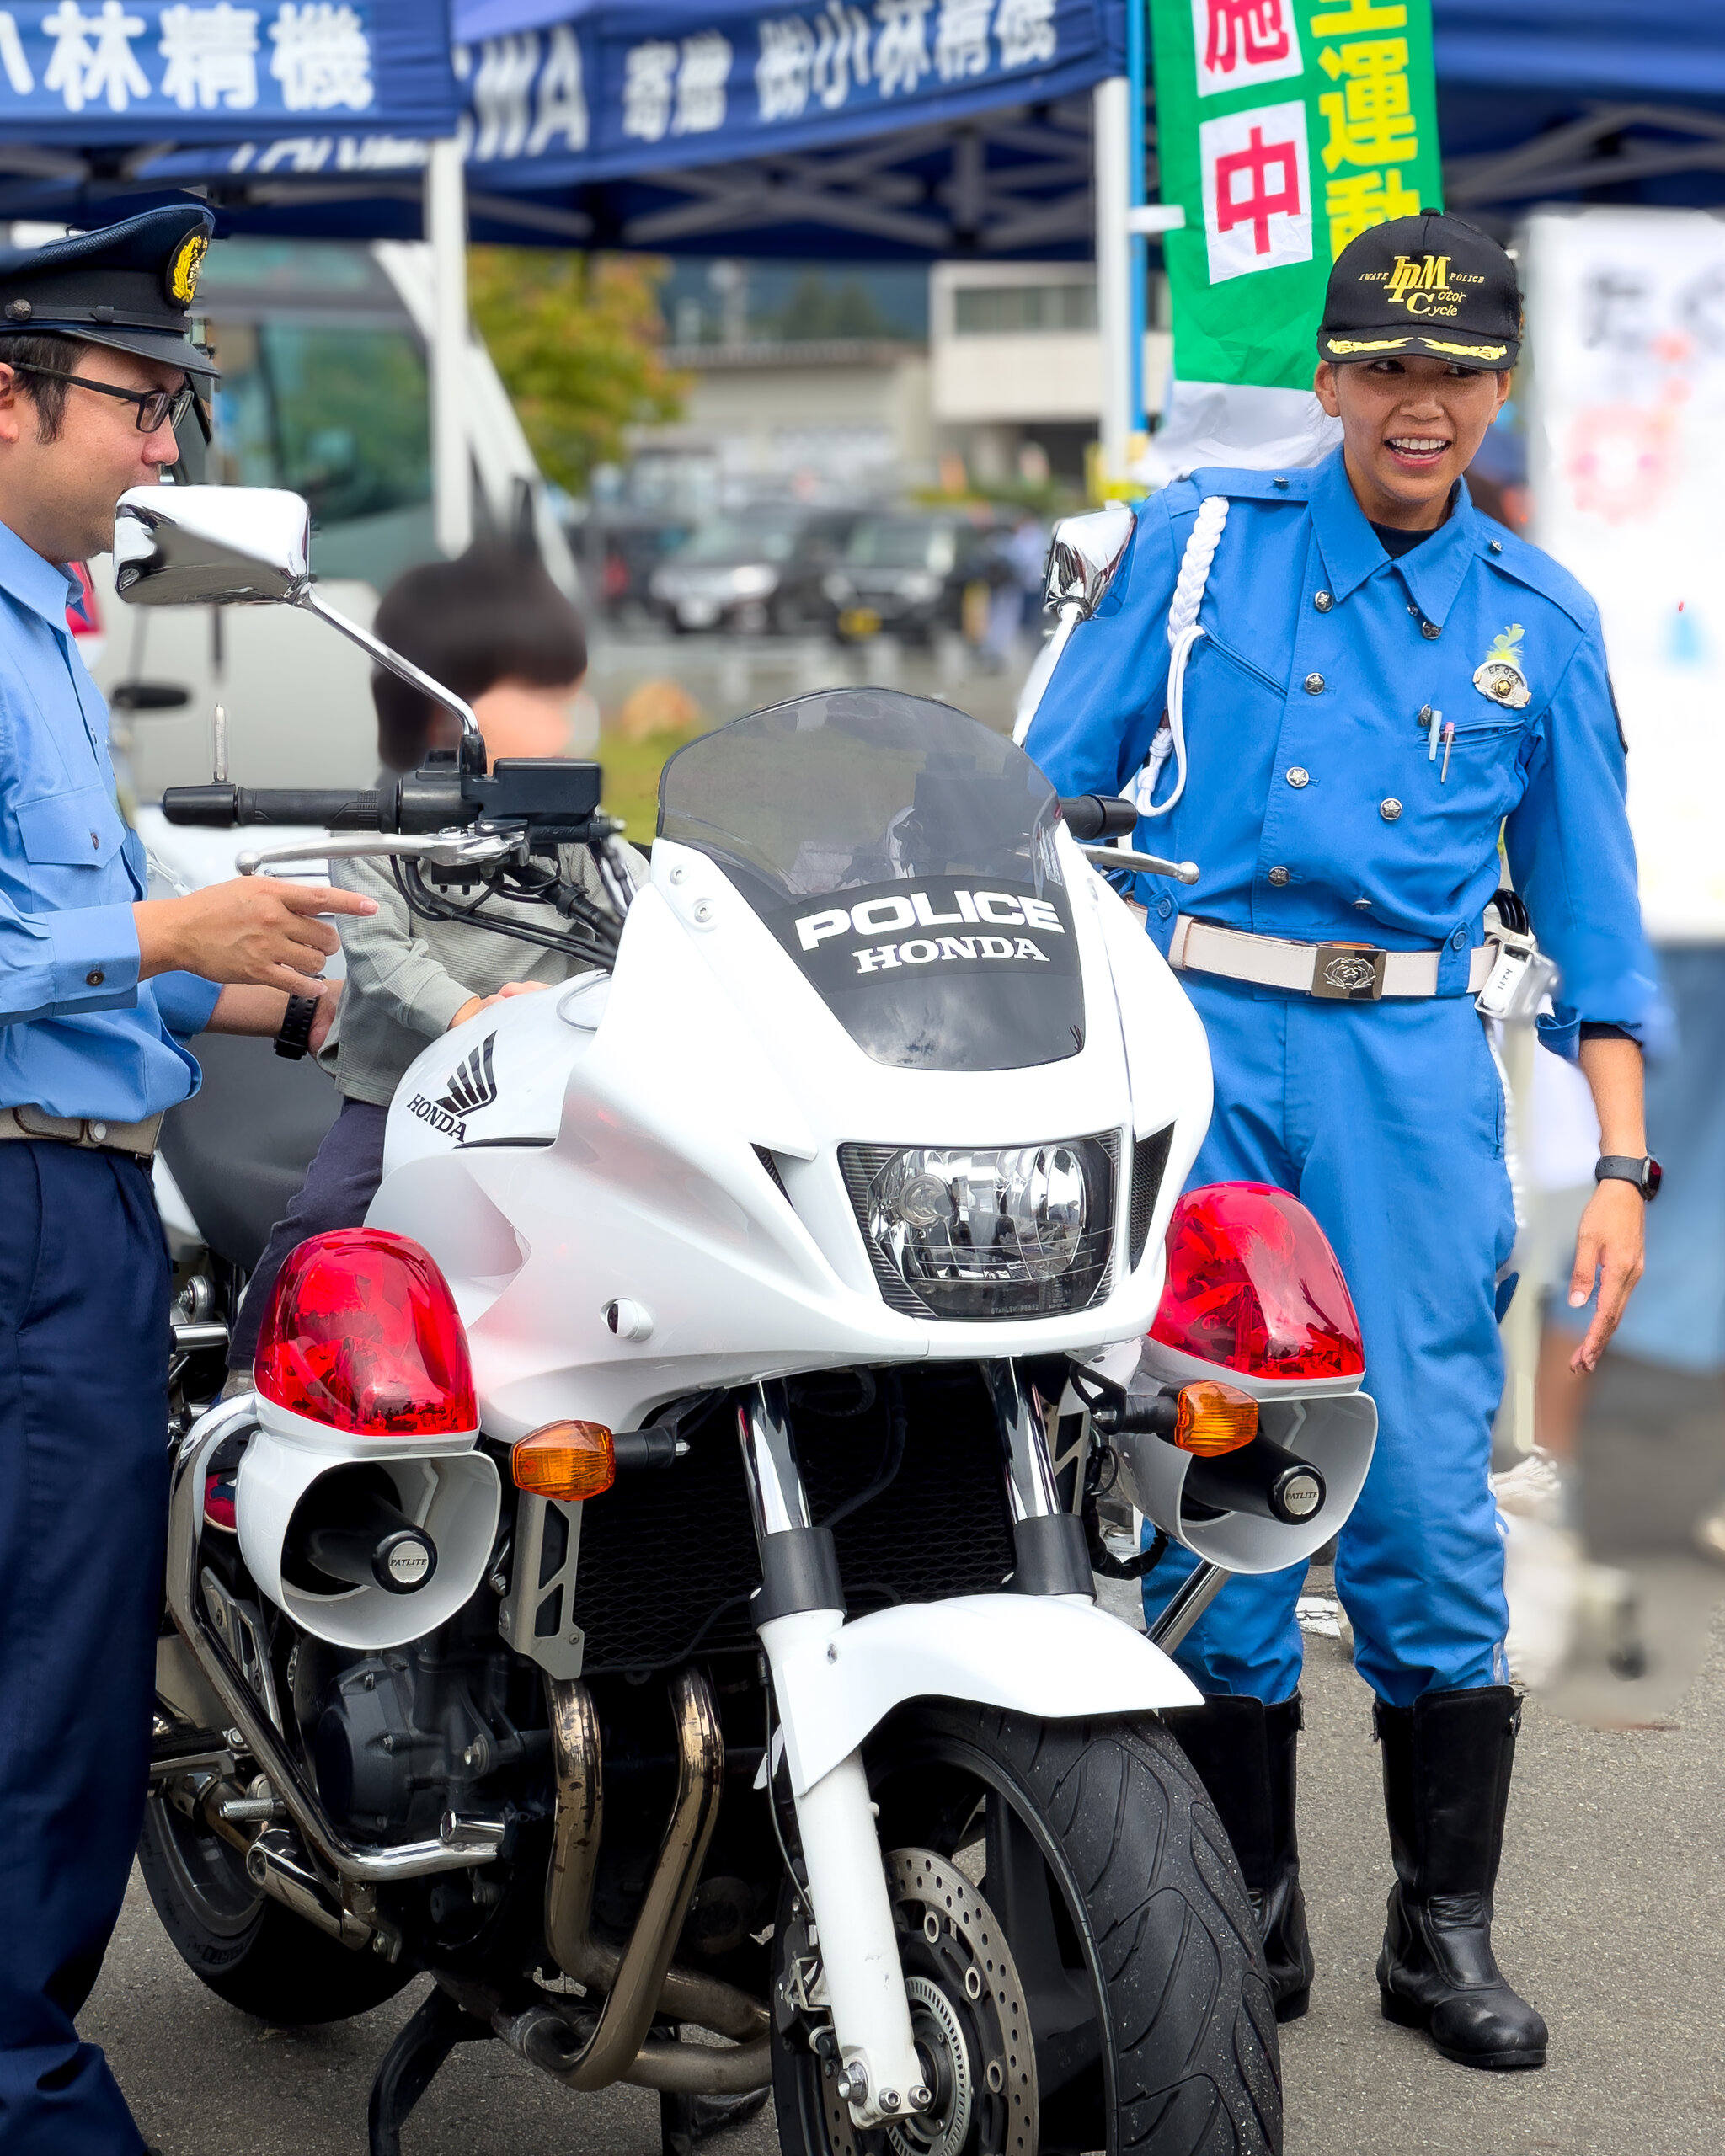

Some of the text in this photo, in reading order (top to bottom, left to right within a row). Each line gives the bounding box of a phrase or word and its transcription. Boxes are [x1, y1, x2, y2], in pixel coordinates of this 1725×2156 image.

[1359, 272, 1389, 280] IWATE
[1449, 273, 1485, 284] POLICE
[1488, 665, 1500, 675] EF
[794, 890, 1065, 952] POLICE
[852, 936, 1051, 974] HONDA
[406, 1093, 467, 1143] HONDA
